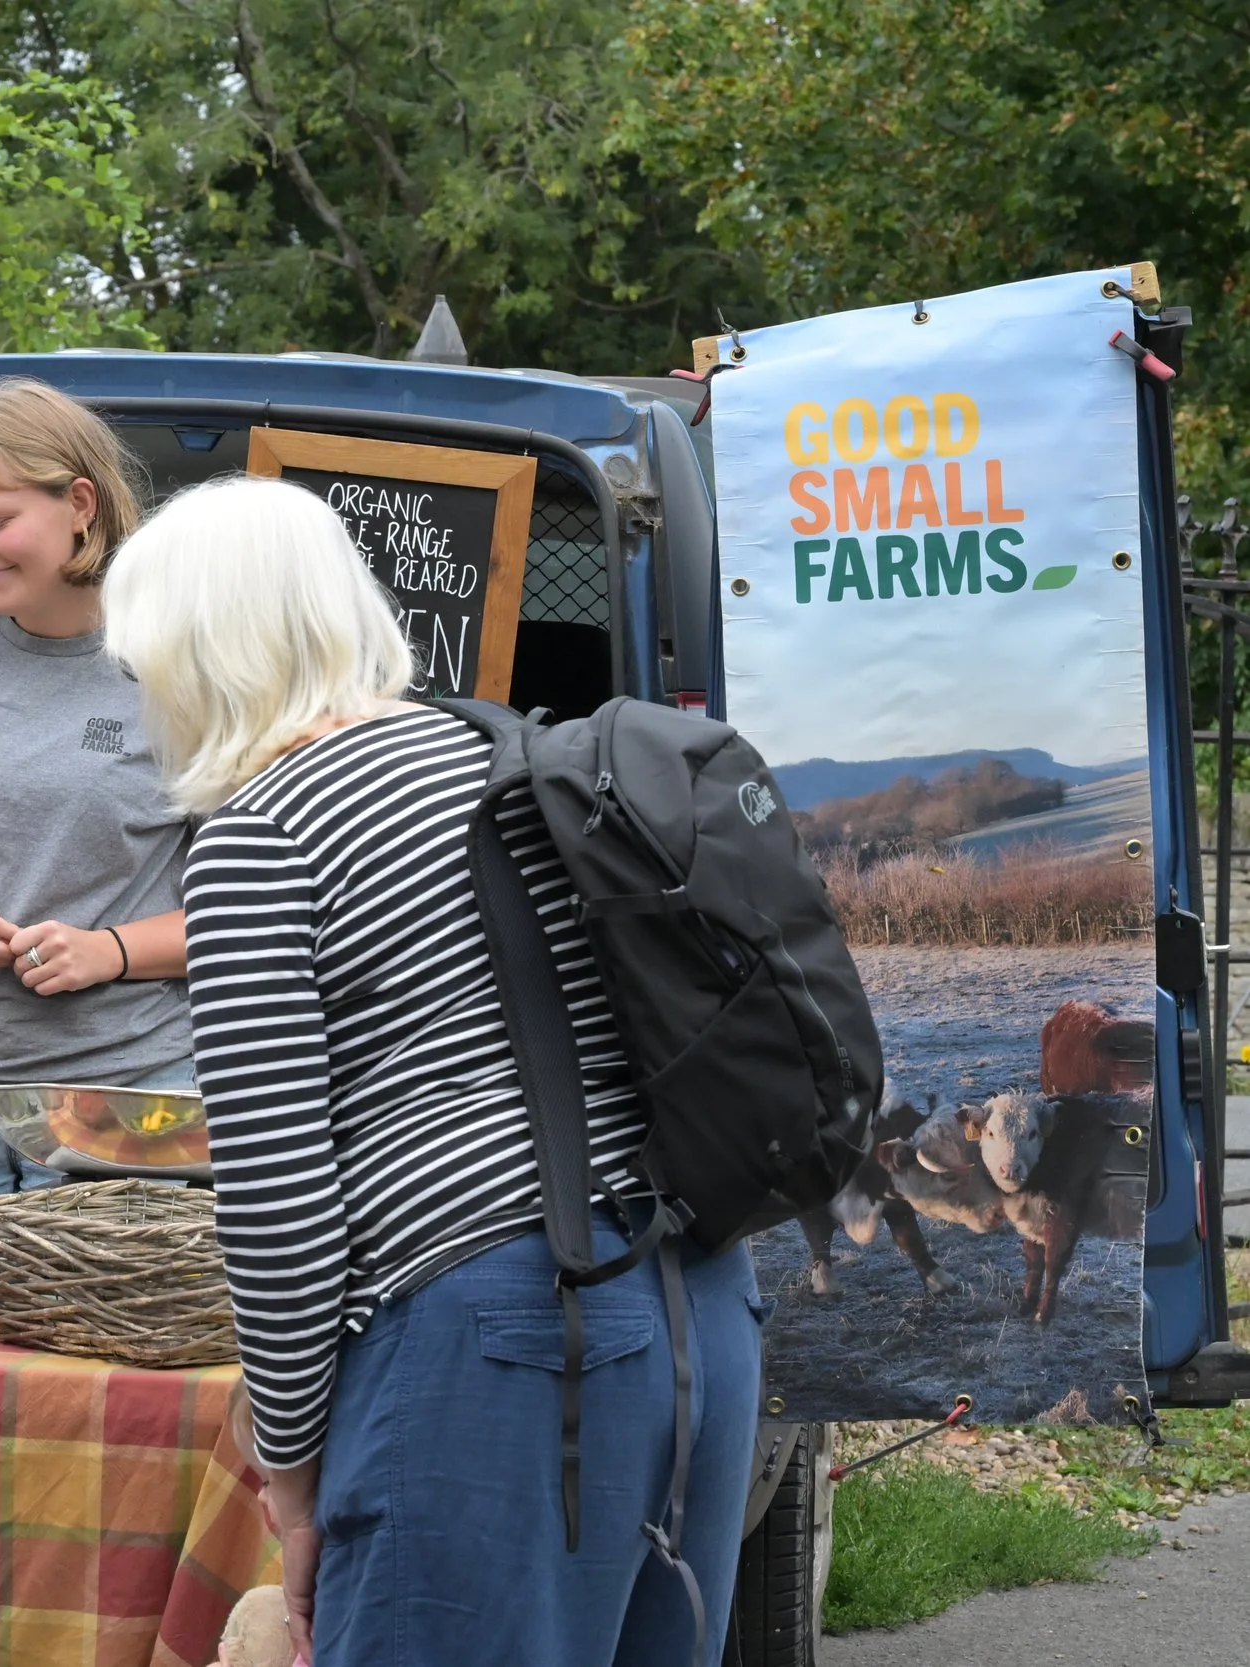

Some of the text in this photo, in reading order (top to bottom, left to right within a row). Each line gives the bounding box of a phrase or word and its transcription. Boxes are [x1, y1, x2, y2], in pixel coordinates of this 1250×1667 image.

[784, 392, 980, 466] GOOD
[327, 482, 432, 525] ORGANIC
[789, 459, 1025, 535] SMALL
[393, 556, 477, 598] REARED
[793, 527, 1028, 604] FARMS
[84, 727, 125, 746] SMALL
[86, 717, 123, 733] GOOD
[81, 739, 124, 754] FARMS
